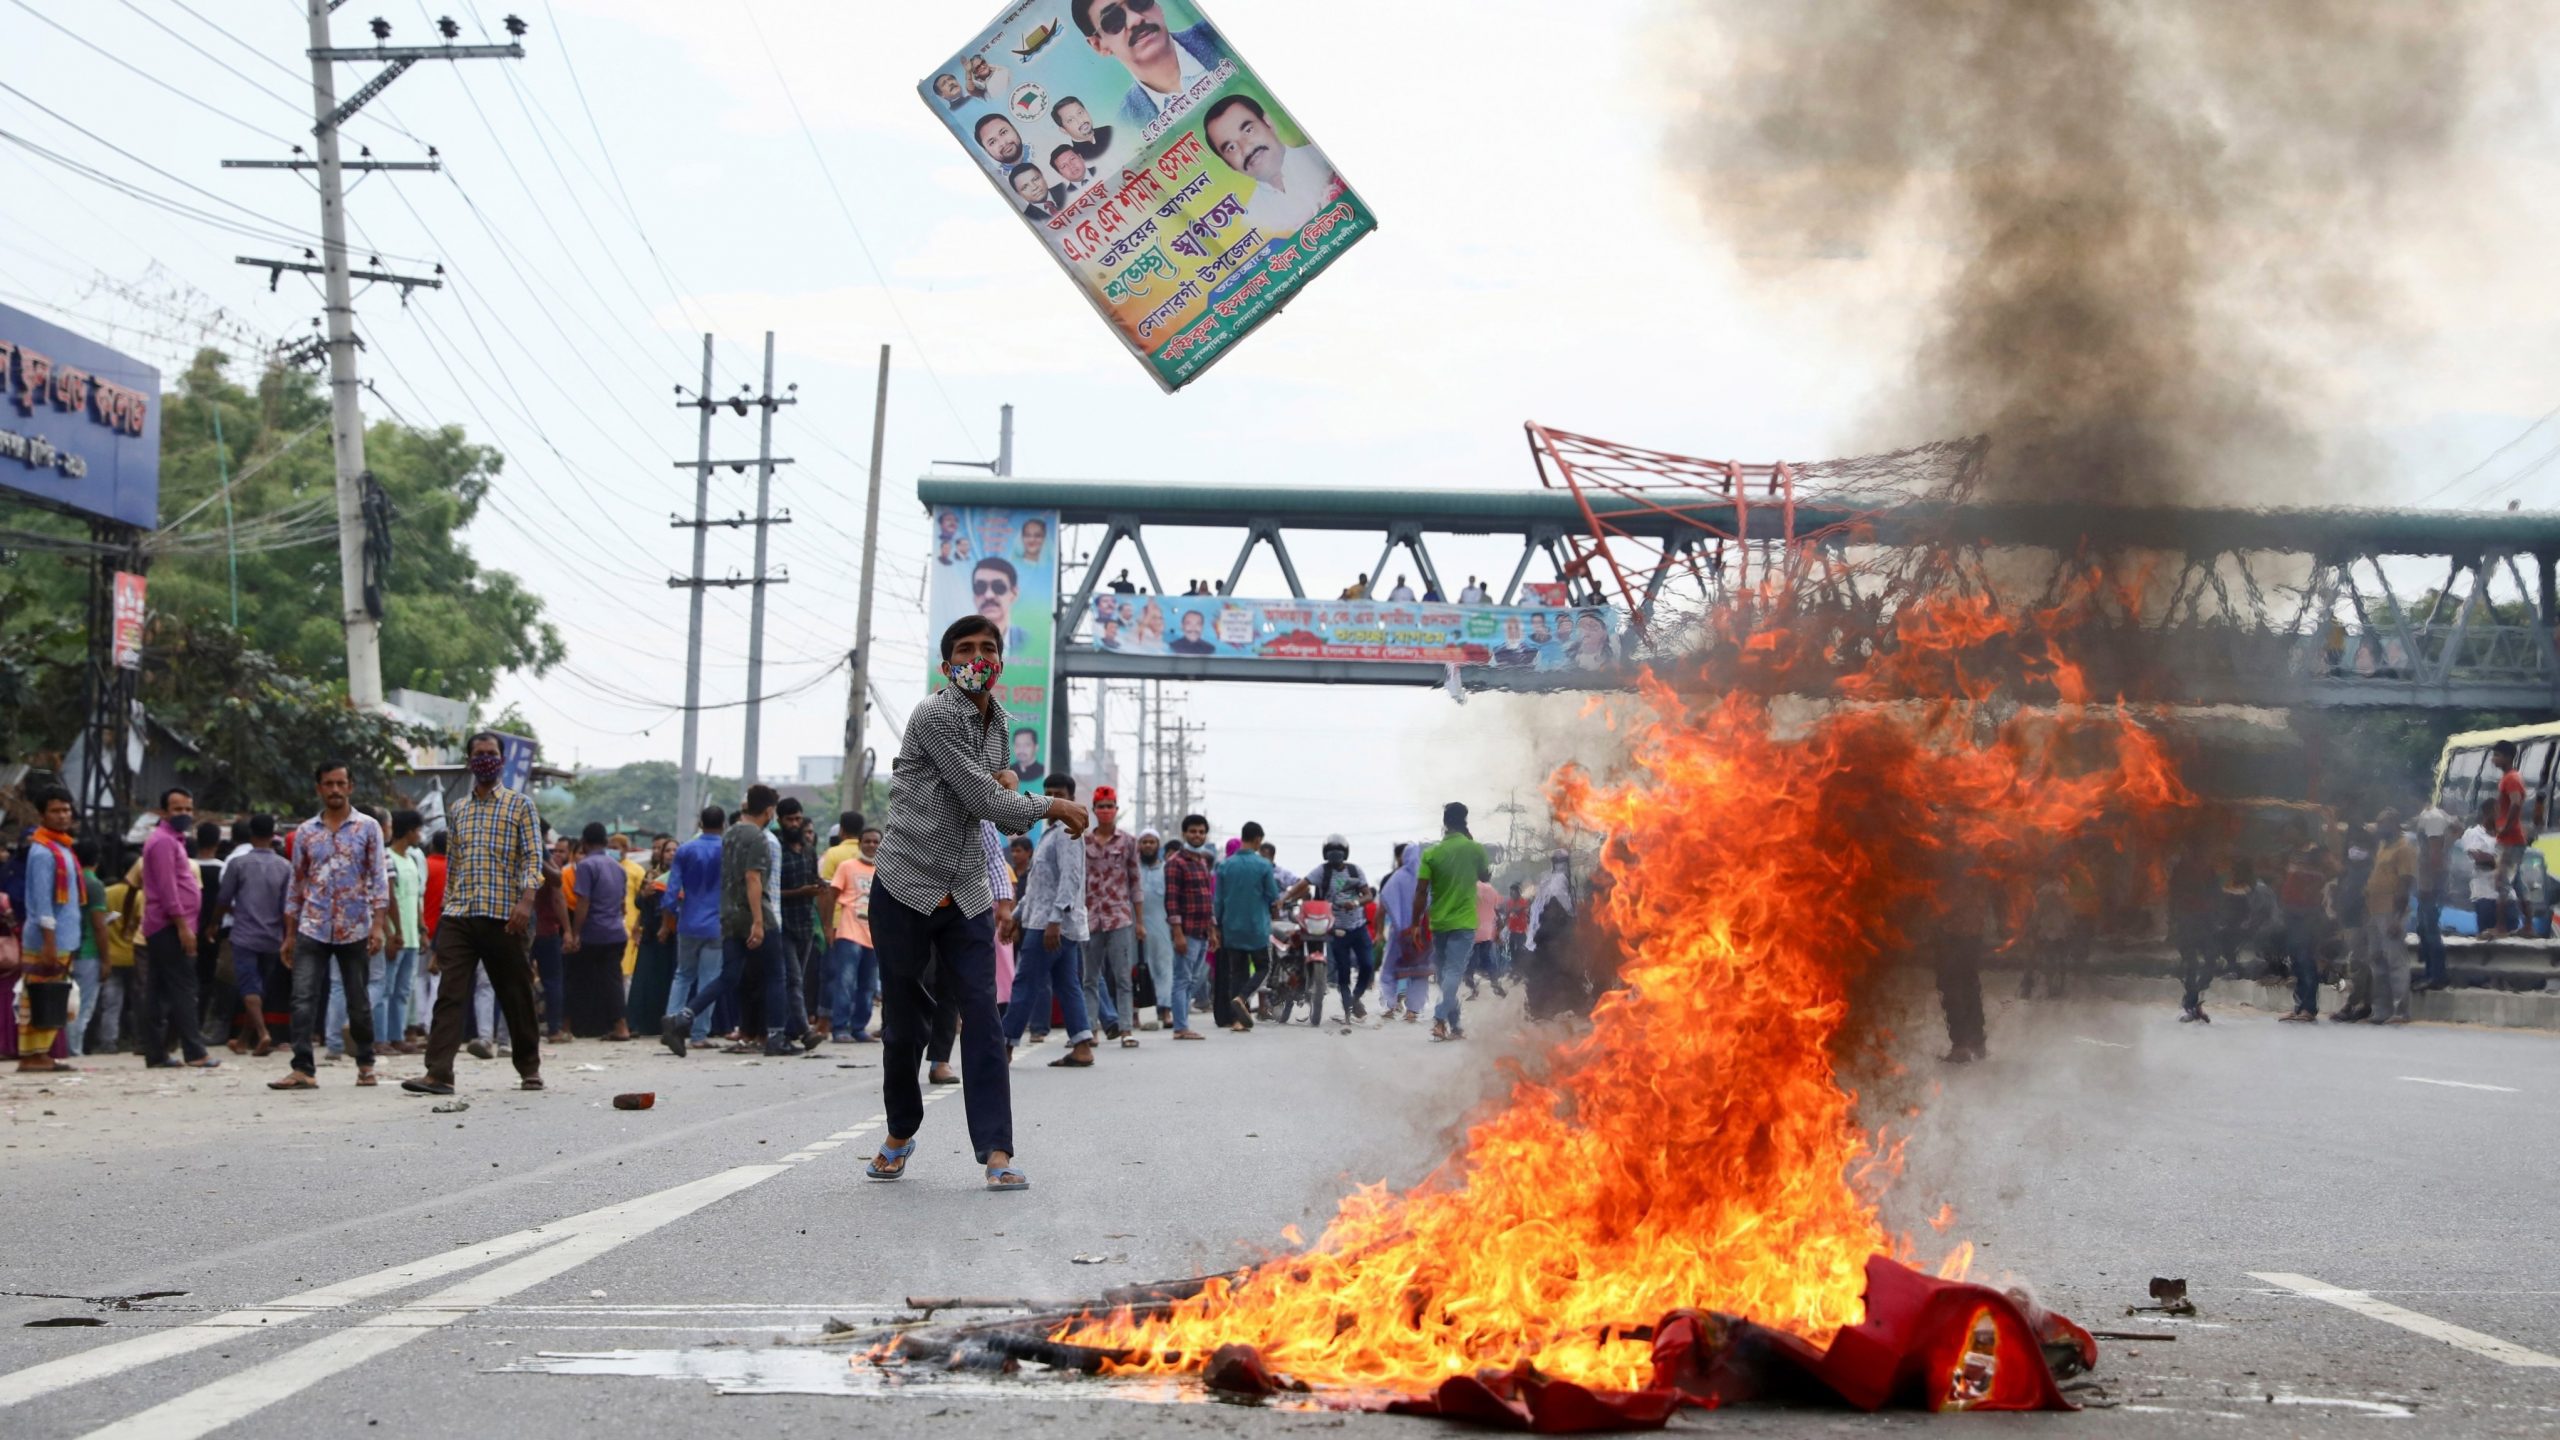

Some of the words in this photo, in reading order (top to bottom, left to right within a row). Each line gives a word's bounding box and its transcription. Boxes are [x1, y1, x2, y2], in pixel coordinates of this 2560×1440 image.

[1189, 74, 1218, 101] ওসমান
[1047, 180, 1109, 232] আলহাজ্ব
[1062, 200, 1129, 262] এ.কে.এম
[1114, 168, 1166, 214] শামীম
[1157, 131, 1209, 182] ওসমান
[1098, 217, 1159, 268] ভাইয়ের
[1155, 170, 1213, 219] আগমন
[1103, 240, 1180, 303] শুভেচ্ছা
[1138, 279, 1202, 338] সোনারগাঁ
[1195, 227, 1264, 284] উপজেলা
[1159, 313, 1221, 361] শফিকুল
[1213, 270, 1273, 317] ইসলাম
[1268, 245, 1303, 273] খাঁন
[1300, 202, 1356, 252] (লিটন)
